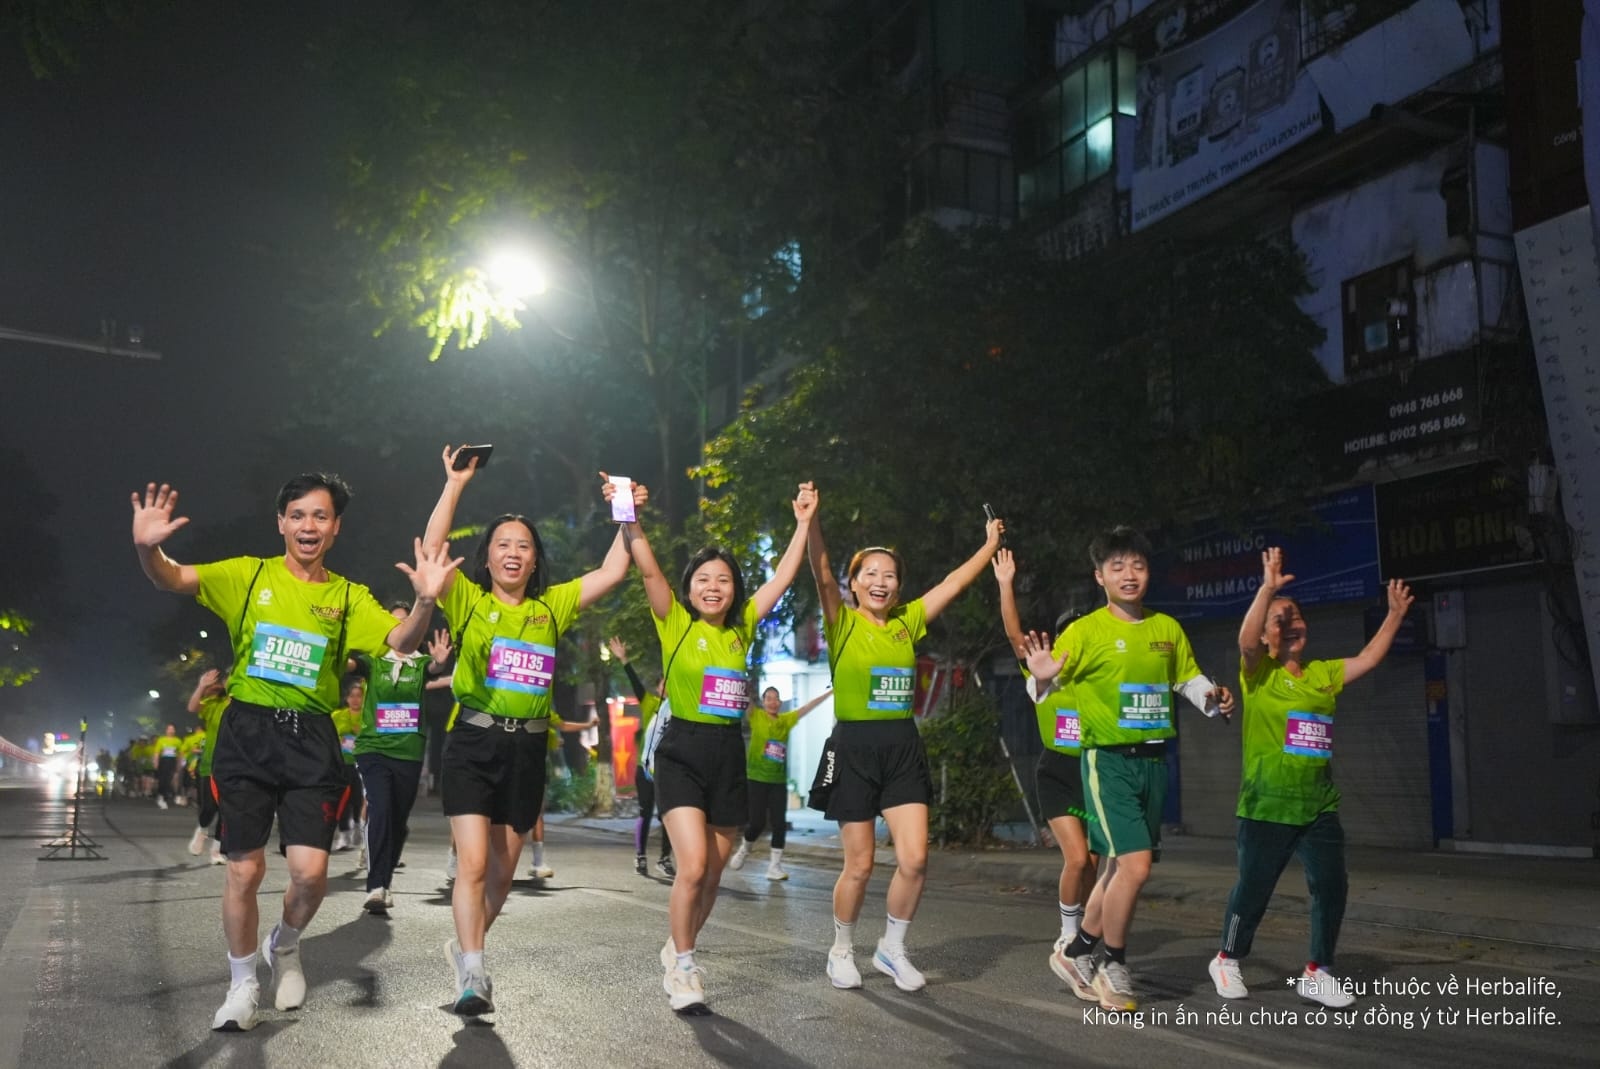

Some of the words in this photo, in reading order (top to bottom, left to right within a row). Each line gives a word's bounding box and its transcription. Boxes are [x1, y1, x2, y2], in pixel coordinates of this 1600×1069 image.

[1389, 399, 1417, 418] 0948
[1420, 393, 1441, 410] 768
[1442, 386, 1464, 404] 668
[1389, 424, 1417, 443] 0902
[1420, 416, 1441, 434] 958
[1443, 412, 1466, 430] 866
[265, 636, 312, 661] 51006
[503, 649, 545, 671] 56135
[714, 678, 747, 695] 56002
[880, 676, 912, 690] 51113
[1132, 694, 1162, 707] 11003
[1065, 718, 1080, 729] 56
